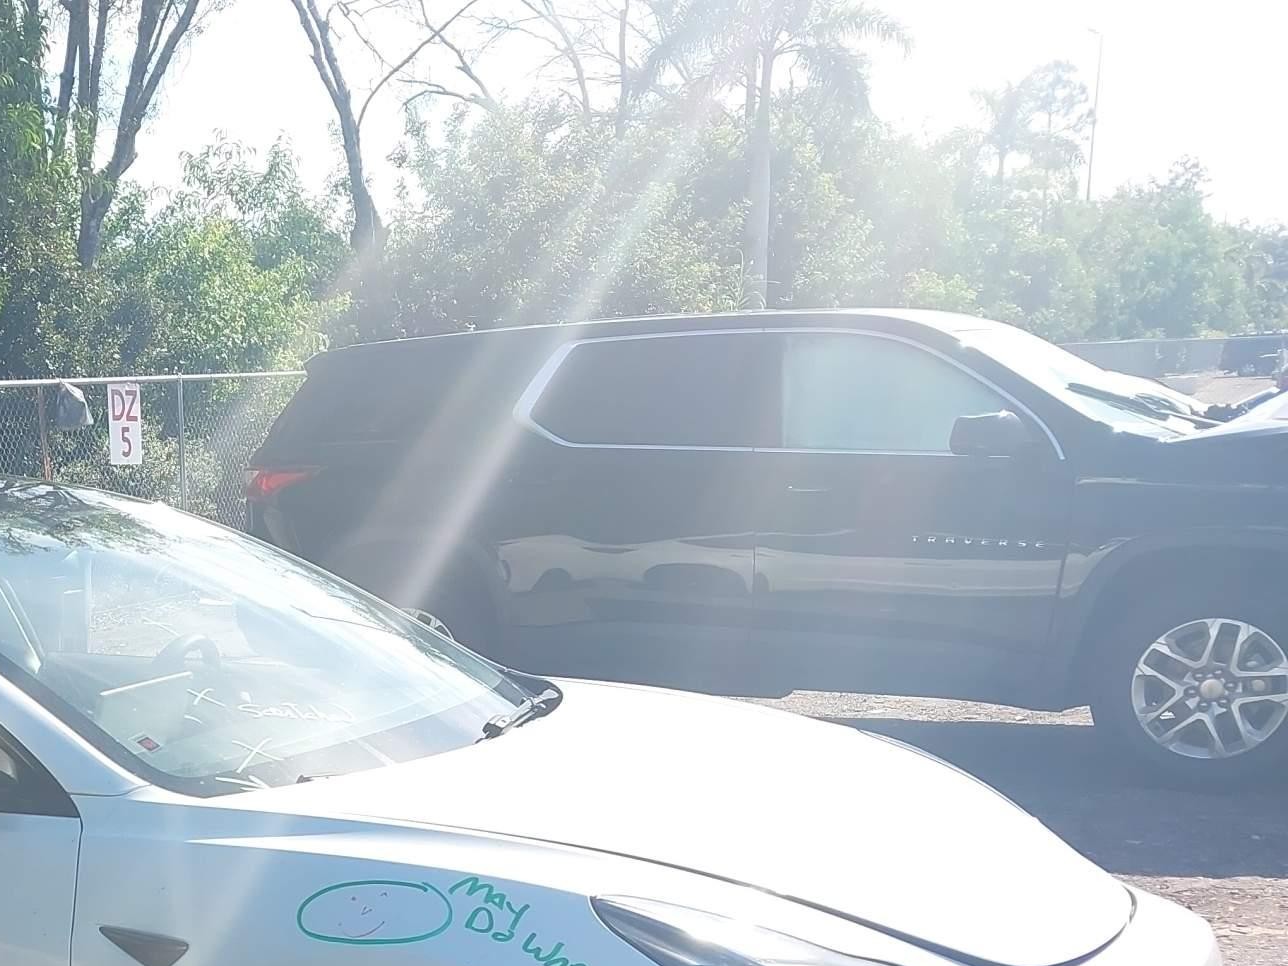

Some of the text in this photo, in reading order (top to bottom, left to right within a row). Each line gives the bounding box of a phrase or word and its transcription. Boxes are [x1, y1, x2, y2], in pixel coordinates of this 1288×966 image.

[111, 388, 139, 422] DZ
[121, 427, 132, 458] 5
[911, 535, 1045, 548] TRAVERSE
